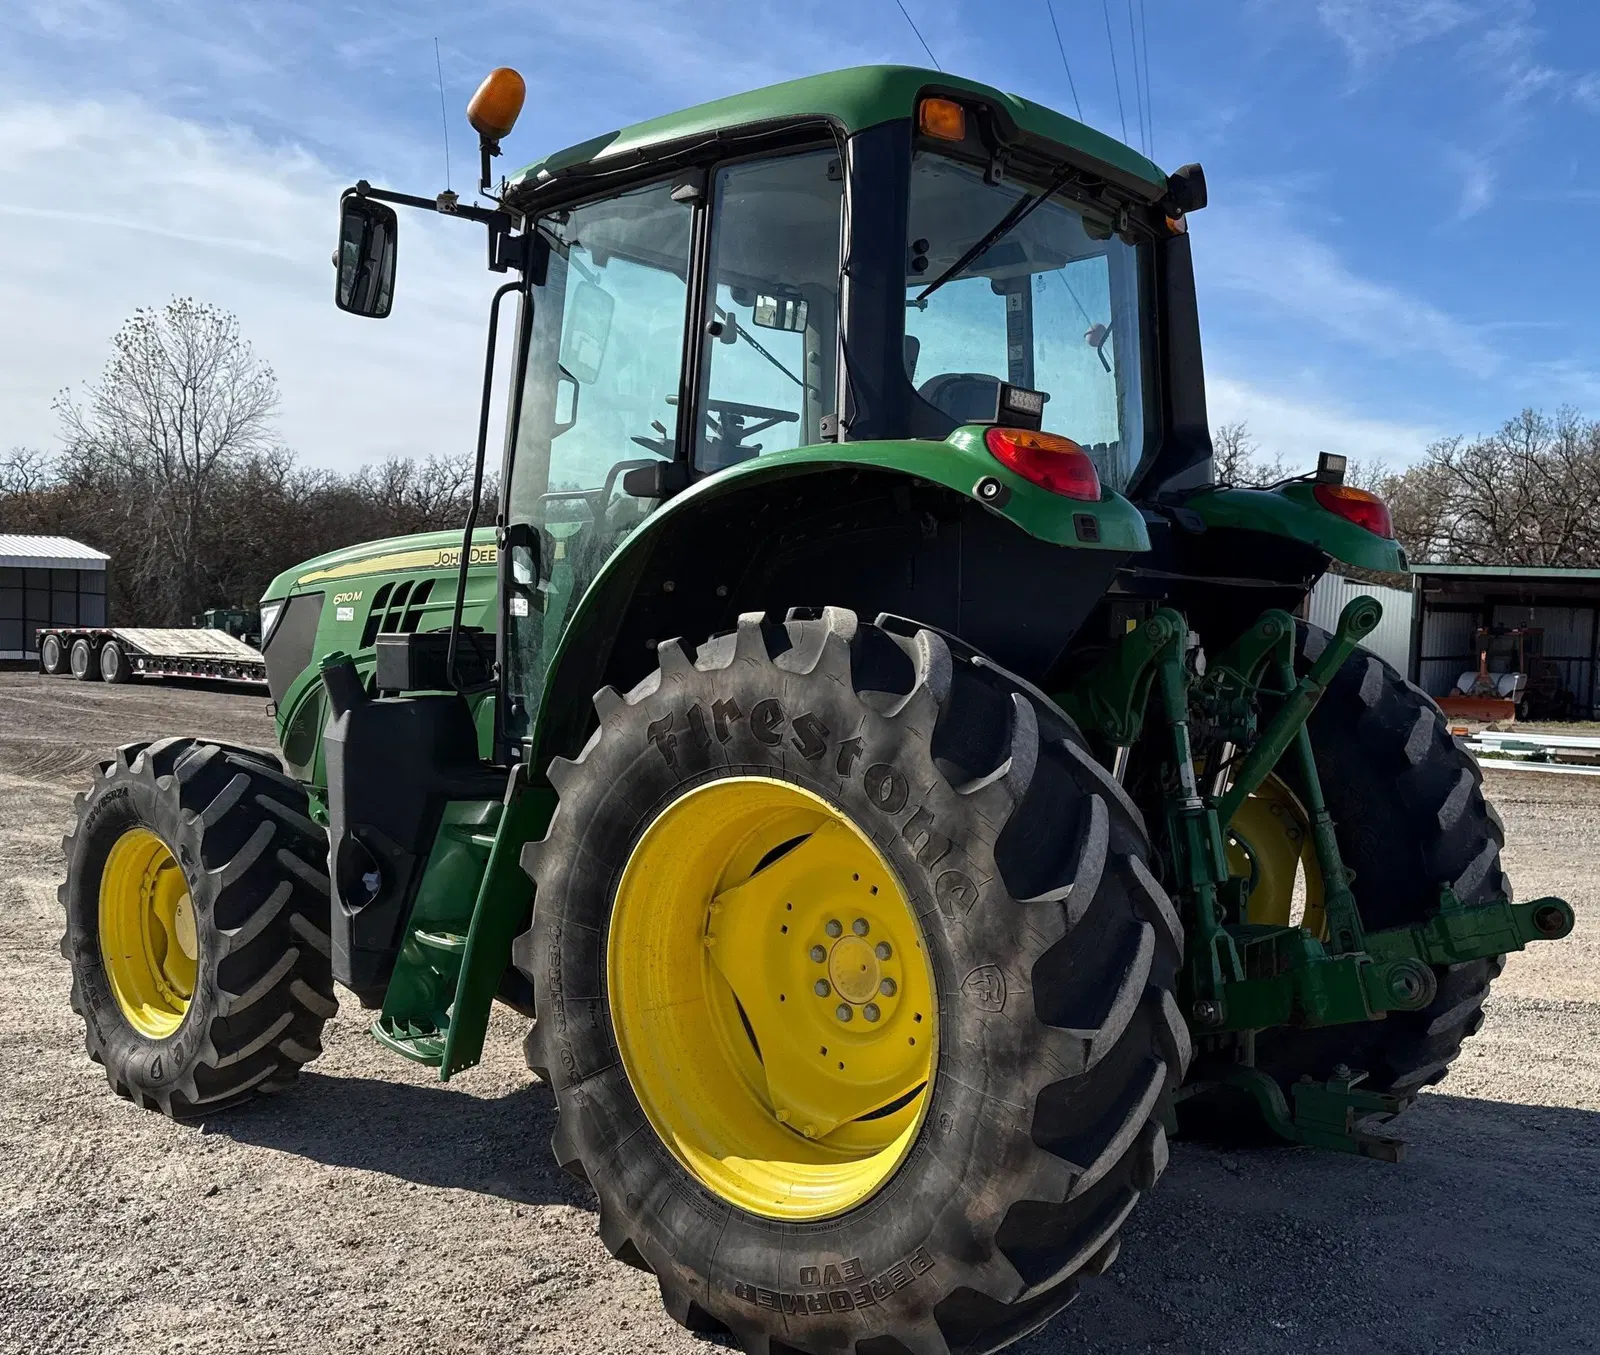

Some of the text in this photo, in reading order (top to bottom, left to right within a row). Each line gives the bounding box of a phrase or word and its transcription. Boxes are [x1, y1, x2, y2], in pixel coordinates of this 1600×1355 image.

[434, 548, 497, 565] JOH DEE
[646, 696, 980, 920] Firestone
[735, 1245, 936, 1315] PERFORMER
[800, 1257, 864, 1287] EVO
